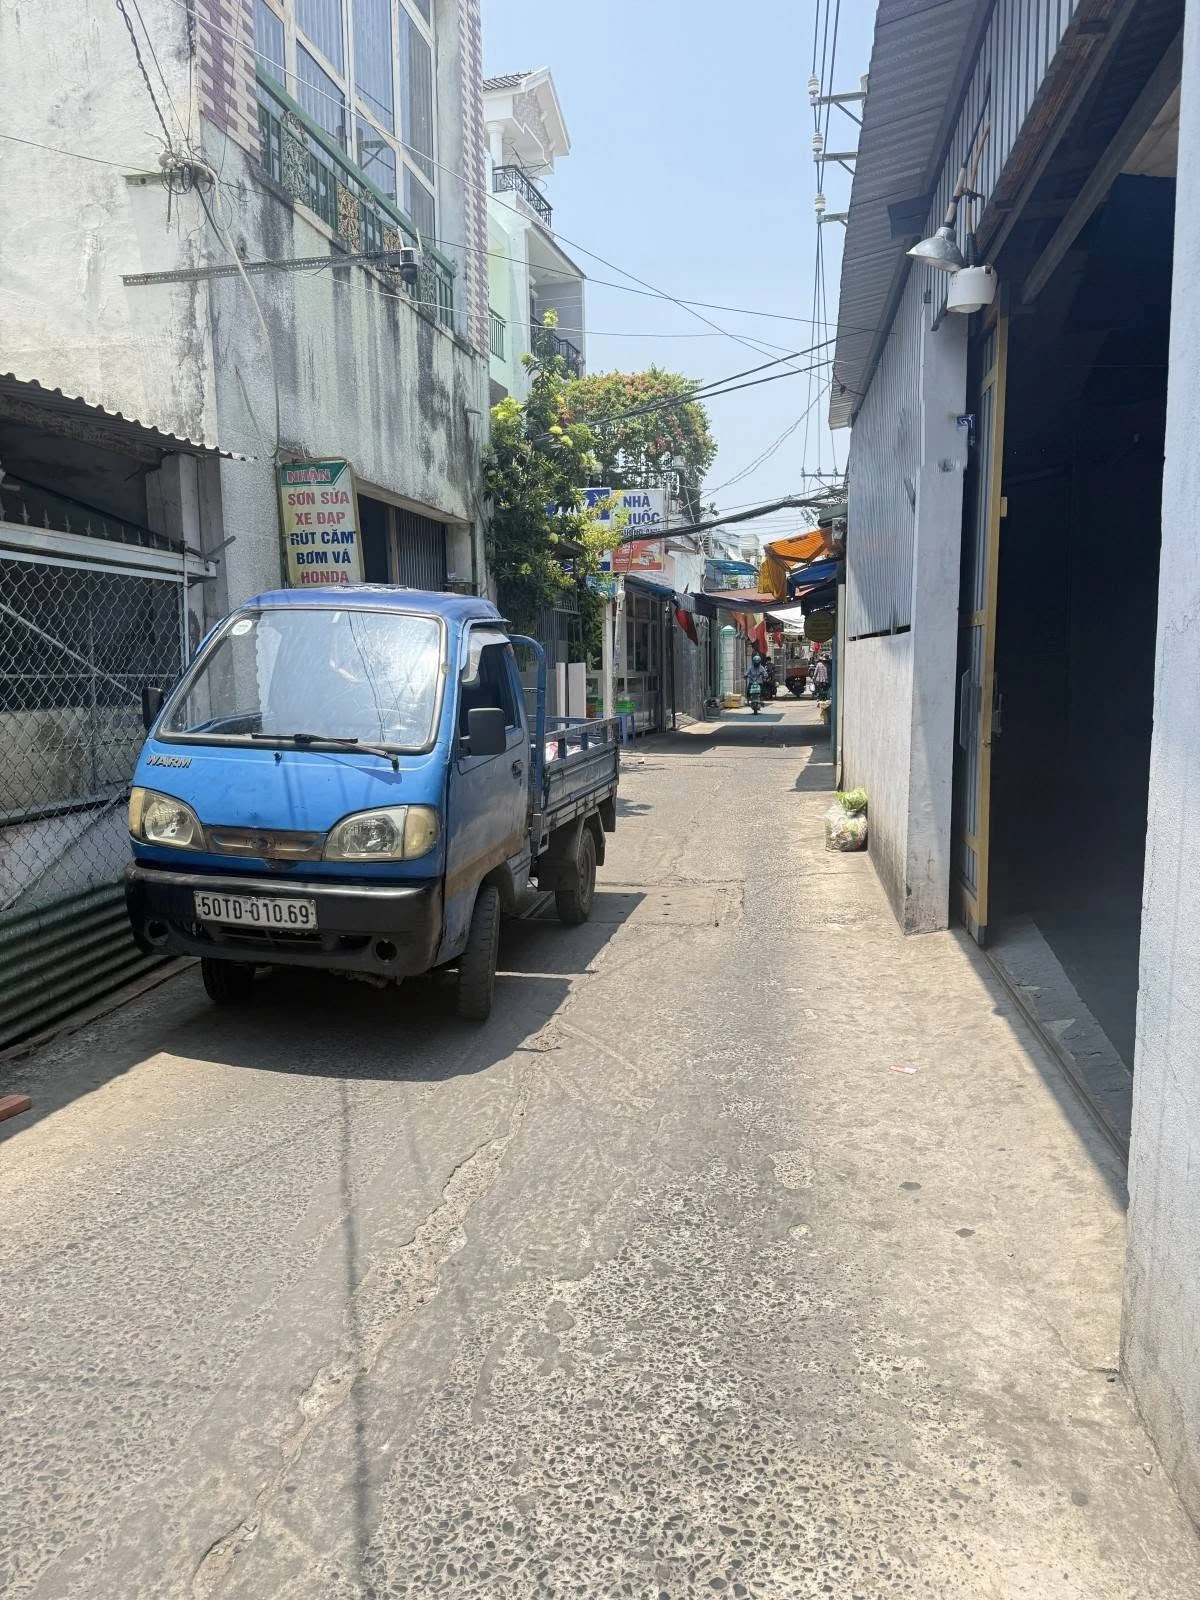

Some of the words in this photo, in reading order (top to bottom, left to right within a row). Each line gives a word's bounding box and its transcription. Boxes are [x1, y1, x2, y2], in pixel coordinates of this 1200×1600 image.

[287, 467, 331, 485] NHẬN
[288, 490, 316, 506] SƠN
[320, 487, 350, 505] SỬA
[623, 492, 651, 508] NHÀ
[295, 512, 313, 526] XE
[316, 511, 346, 528] ĐẠP
[290, 529, 317, 546] RÚT
[320, 528, 356, 544] CĂM
[296, 550, 328, 565] BƠM
[331, 548, 352, 564] VÁ
[300, 570, 350, 584] HONDA
